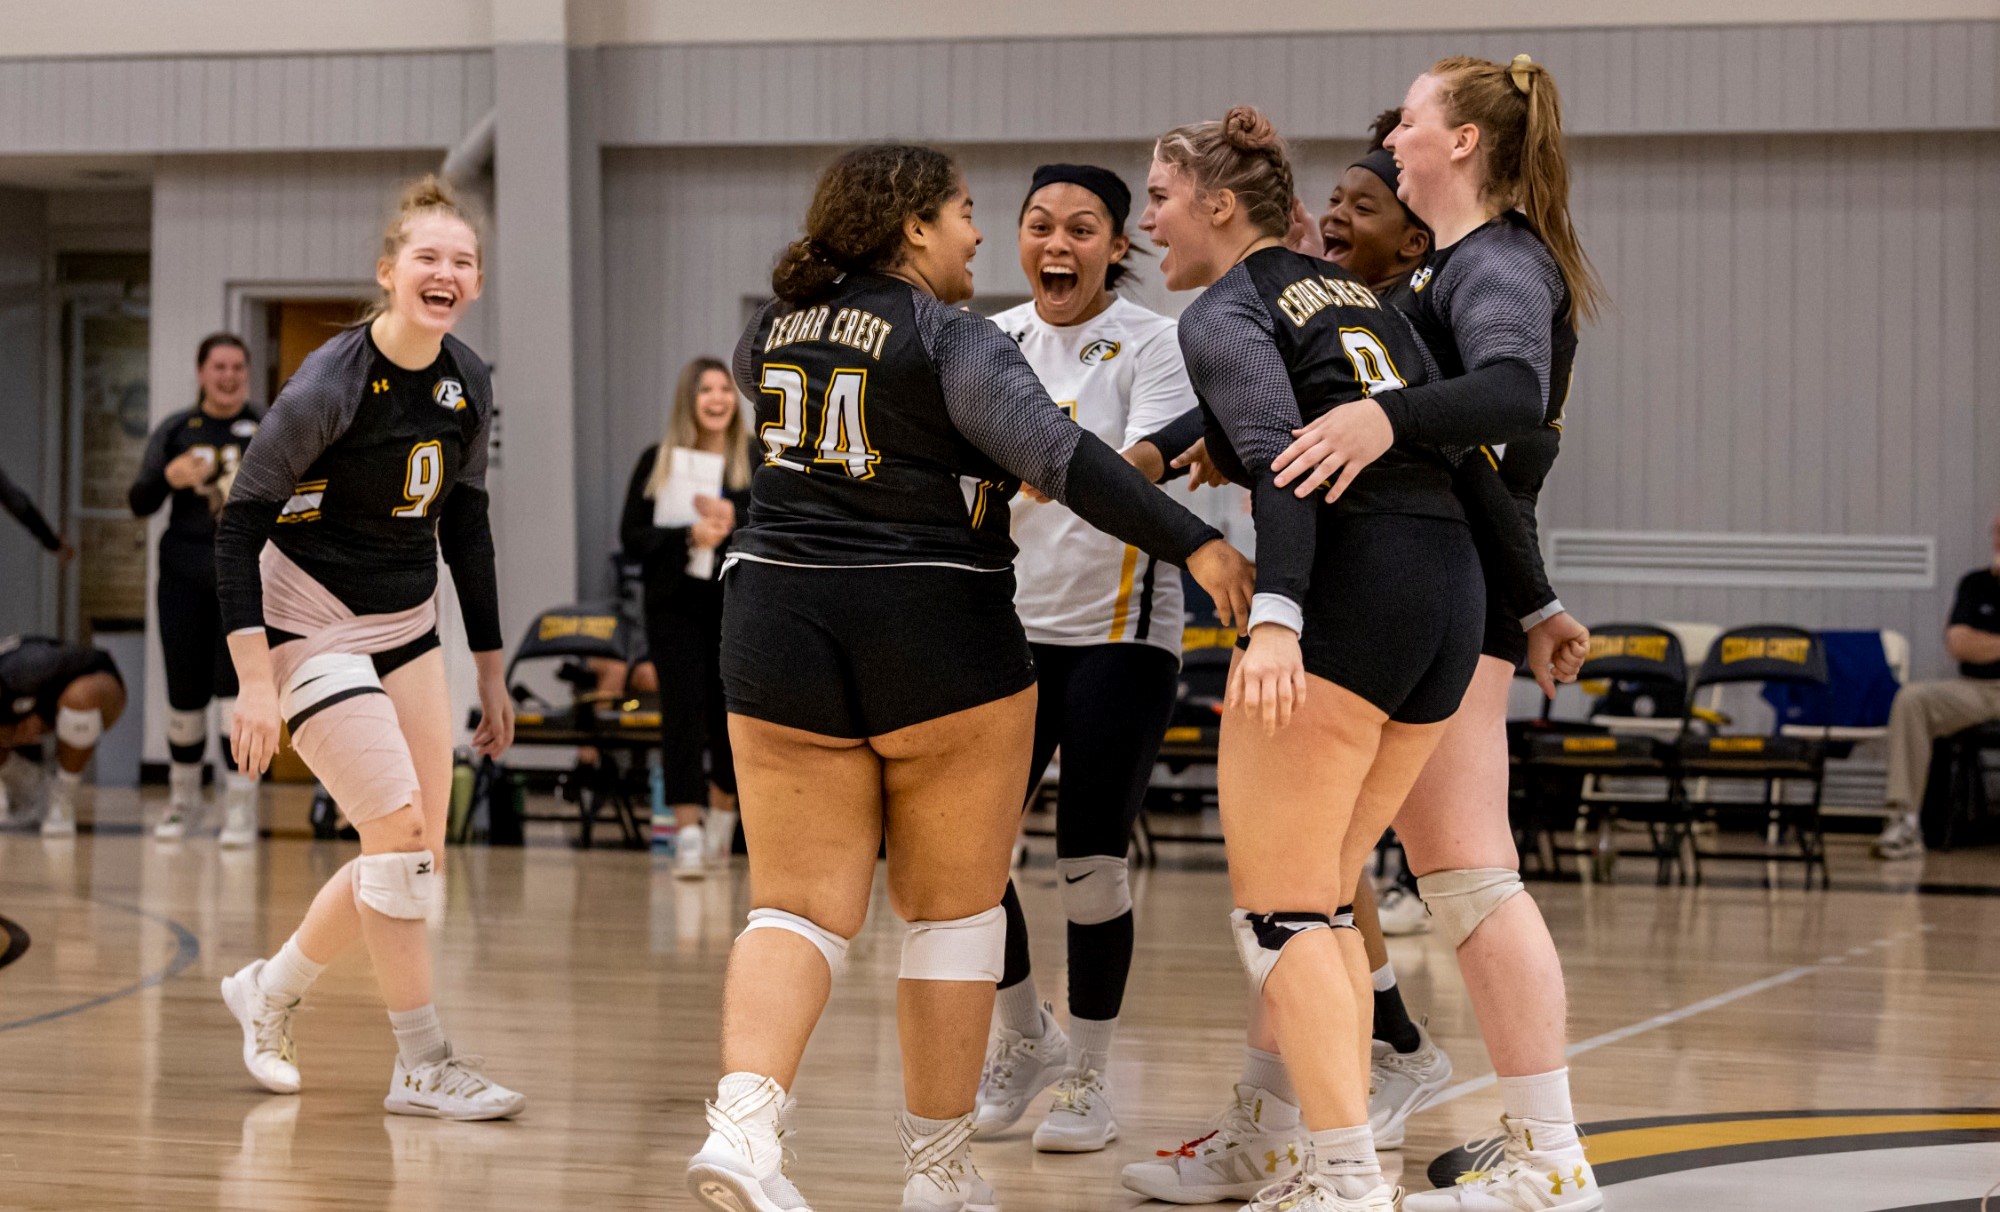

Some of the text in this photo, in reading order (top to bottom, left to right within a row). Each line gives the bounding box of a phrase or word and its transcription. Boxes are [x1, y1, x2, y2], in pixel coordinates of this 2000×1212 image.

[764, 305, 892, 360] CEDAR CREST
[760, 363, 882, 480] 24
[391, 440, 444, 517] 9
